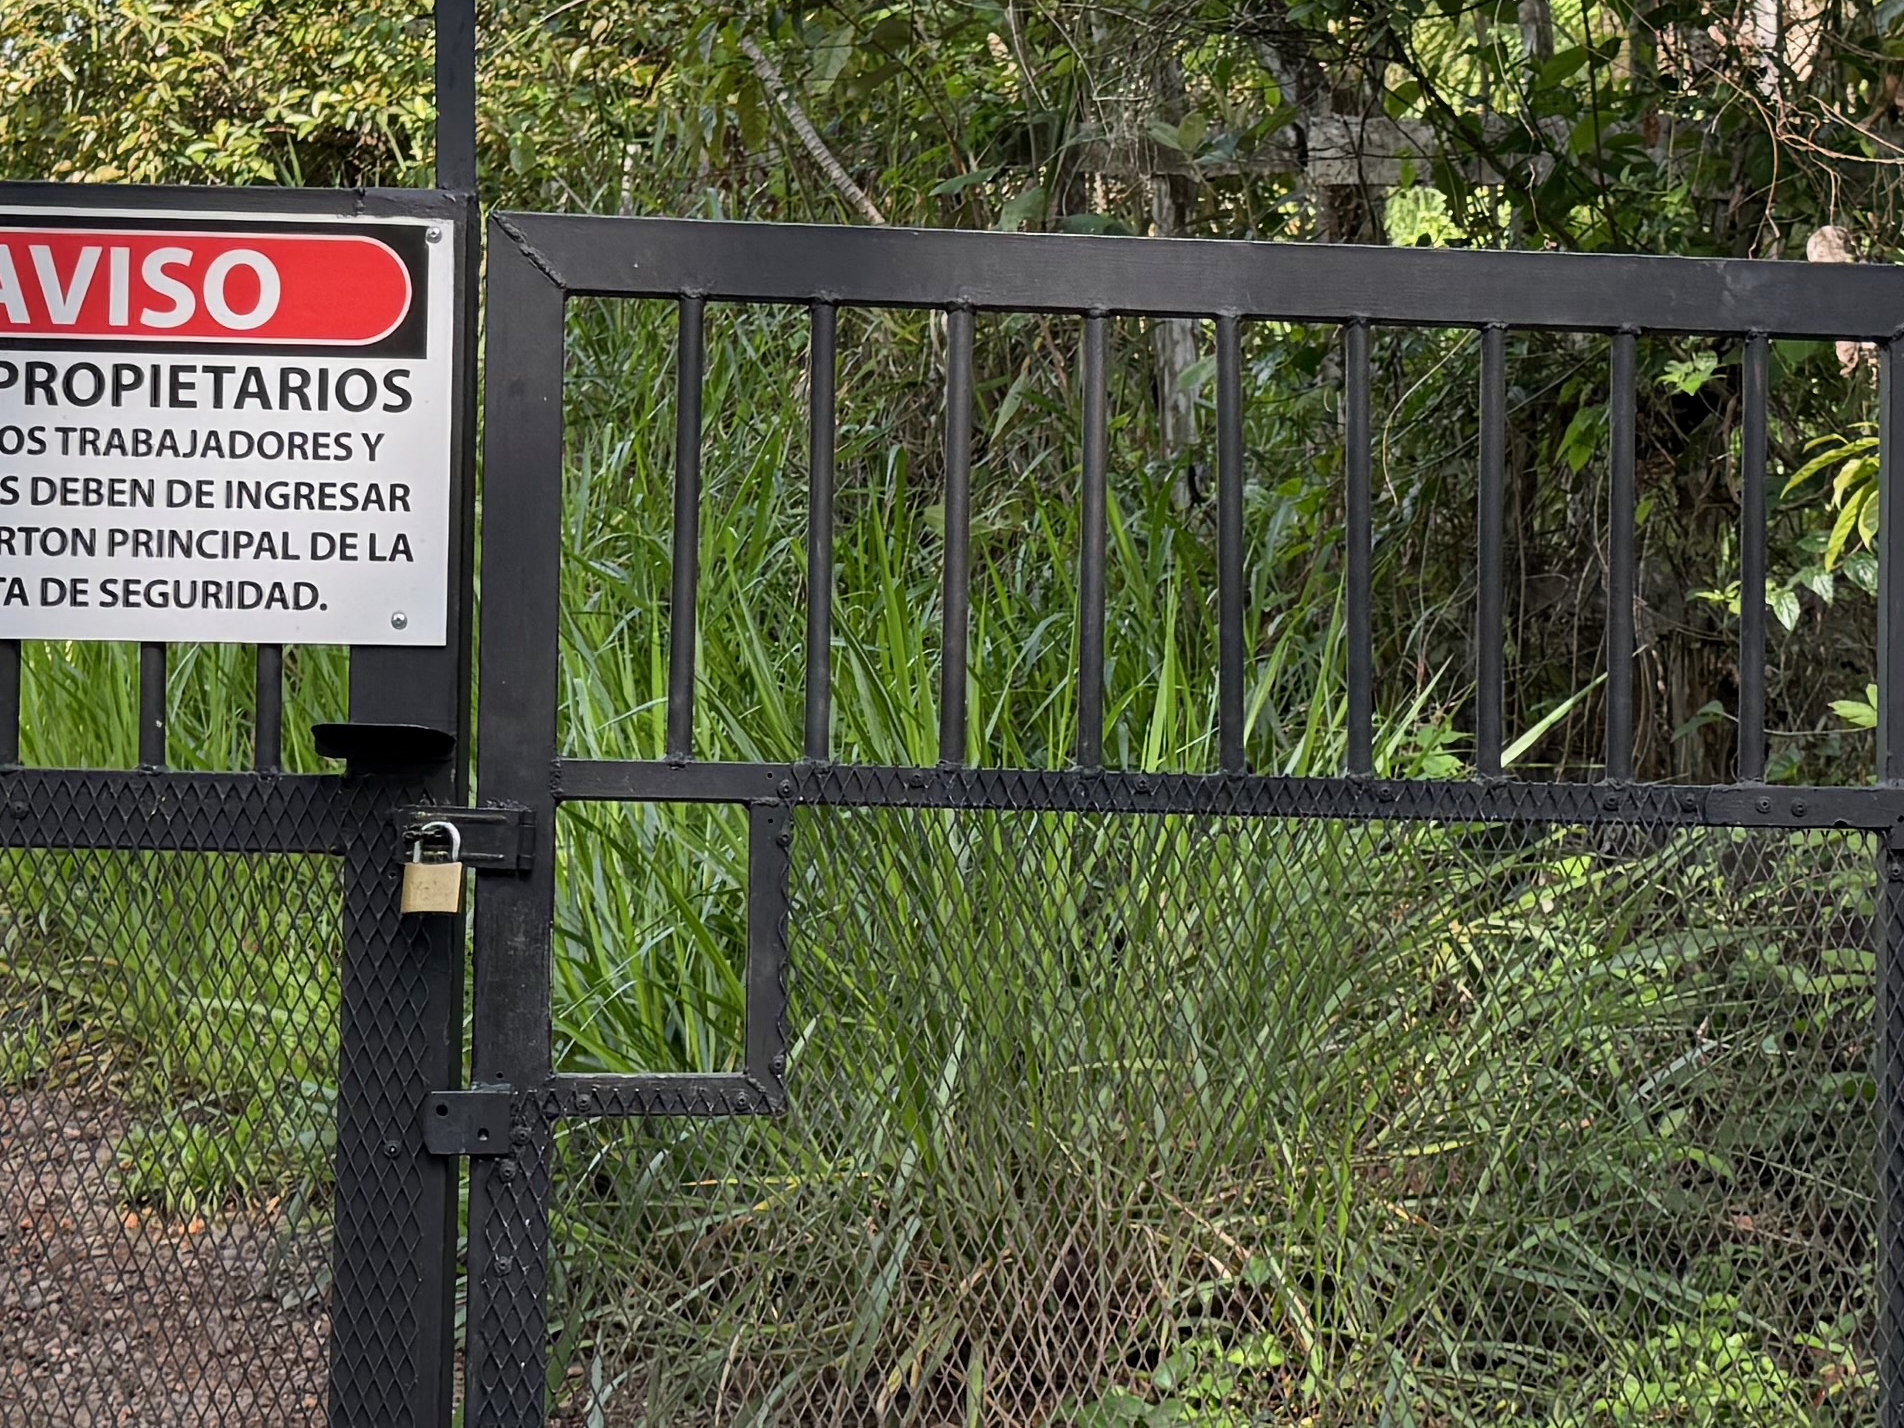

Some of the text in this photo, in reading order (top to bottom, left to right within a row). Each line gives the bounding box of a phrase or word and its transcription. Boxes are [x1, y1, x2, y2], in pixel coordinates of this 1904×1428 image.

[55, 427, 352, 460] TRABAJADORES
[362, 433, 384, 461] Y
[31, 477, 154, 507] DEBEN
[167, 480, 214, 508] DE
[226, 481, 410, 511] INGRESAR
[109, 529, 300, 560] PRINCIPAL
[311, 532, 357, 561] DE
[369, 533, 413, 561] LA
[41, 578, 88, 606] DE
[100, 579, 327, 610] SEGURIDAD.
